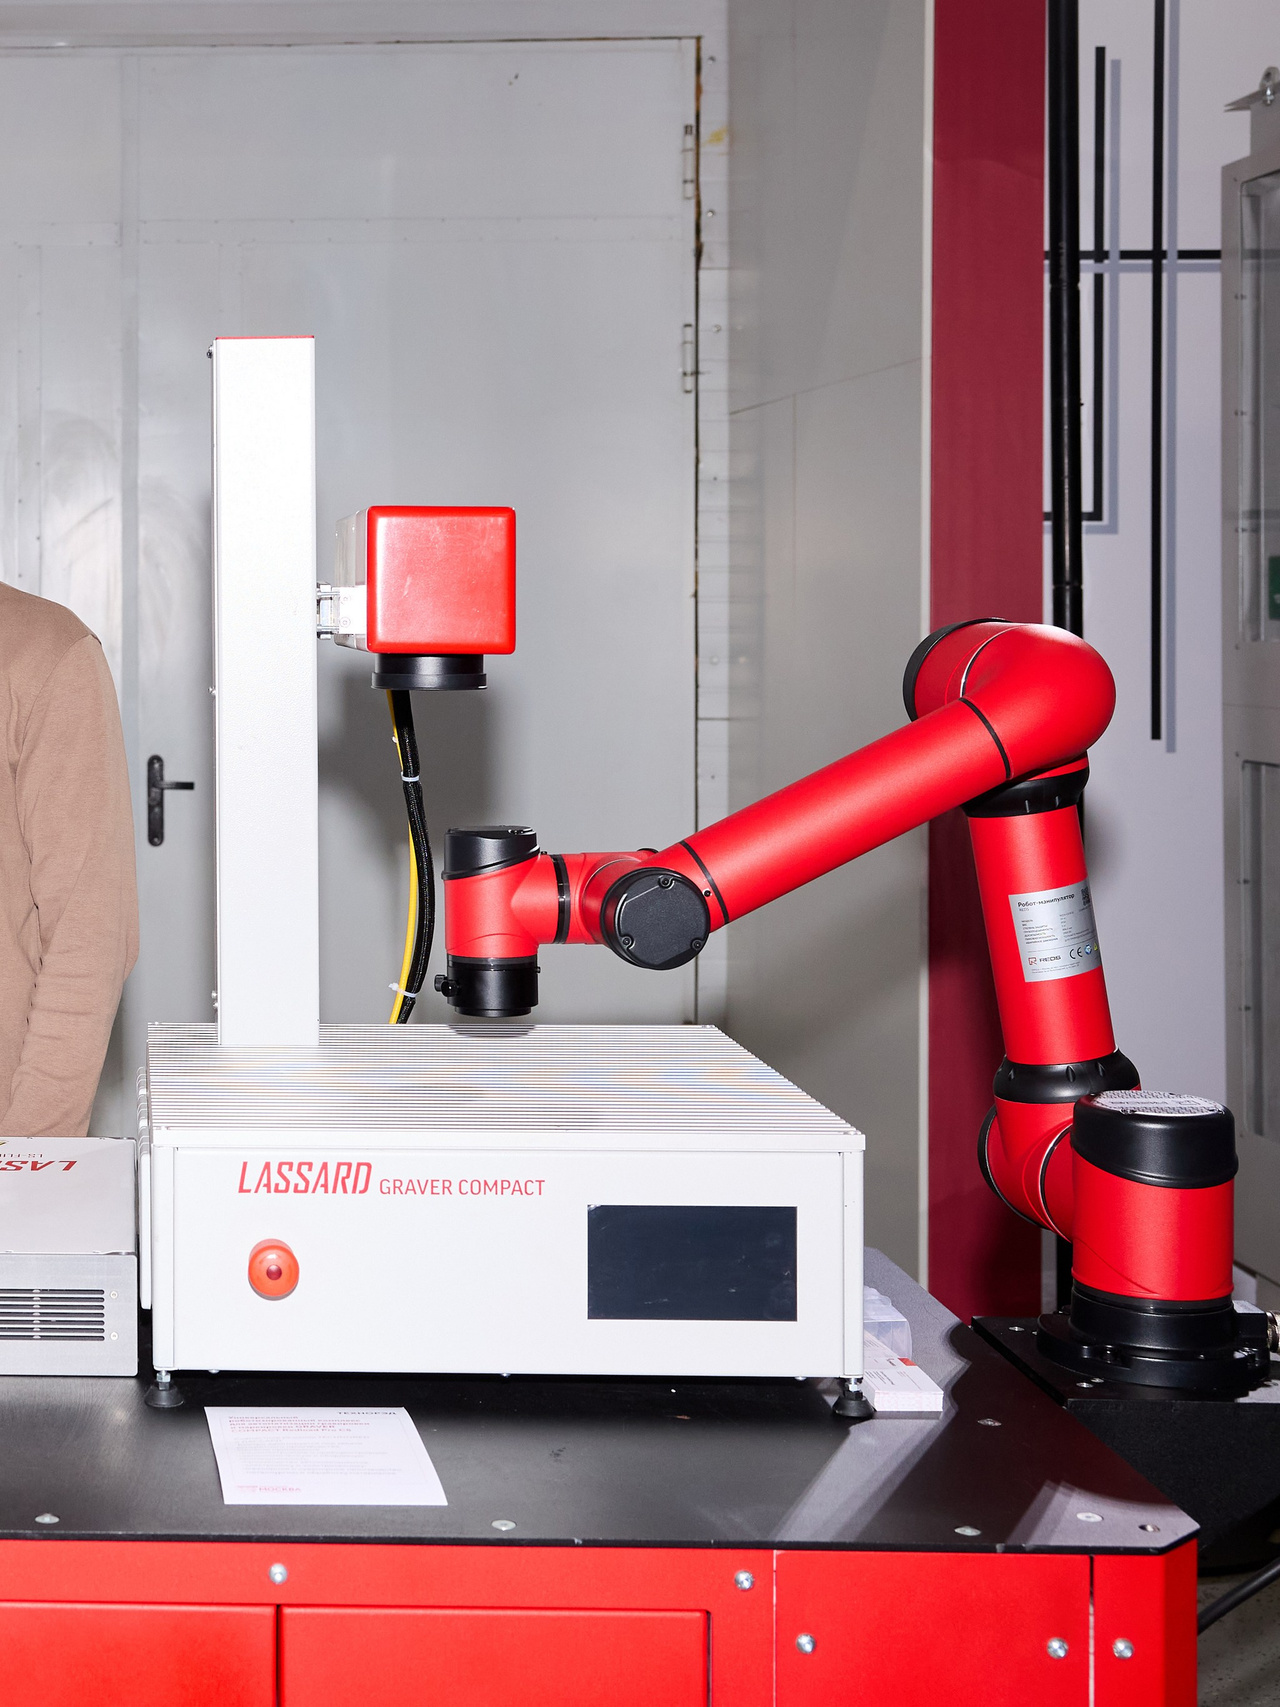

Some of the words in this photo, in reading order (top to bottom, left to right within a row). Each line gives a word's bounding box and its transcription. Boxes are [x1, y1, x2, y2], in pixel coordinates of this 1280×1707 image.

[238, 1161, 373, 1194] LASSARD
[379, 1178, 453, 1196] GRAVER
[458, 1179, 546, 1196] COMPACT
